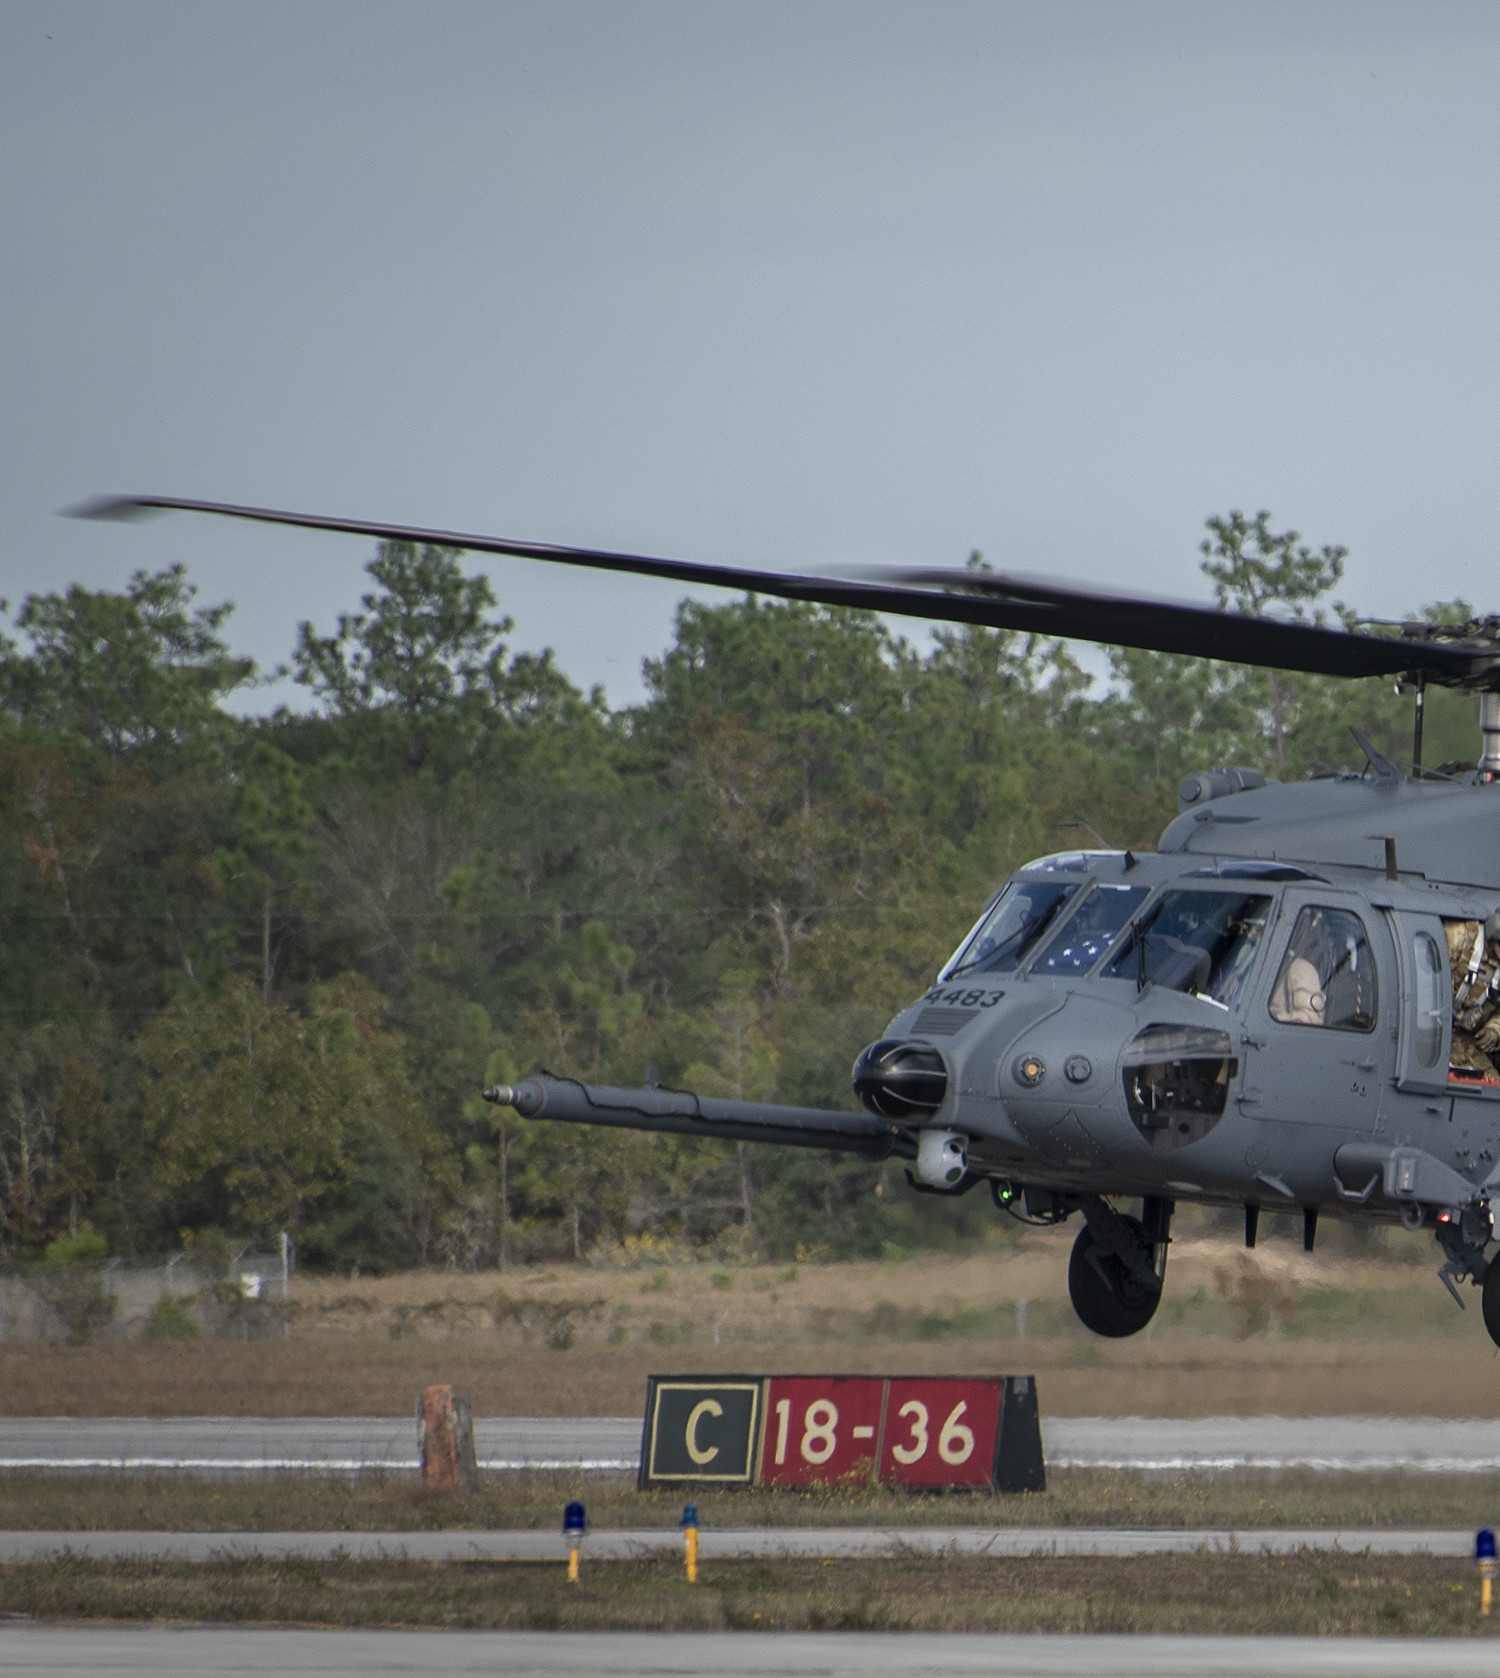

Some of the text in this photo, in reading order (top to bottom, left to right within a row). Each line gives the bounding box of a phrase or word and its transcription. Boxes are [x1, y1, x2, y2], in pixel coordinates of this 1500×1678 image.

[924, 988, 1005, 1008] 4483
[685, 1399, 723, 1465] C
[774, 1398, 975, 1466] 18-36
